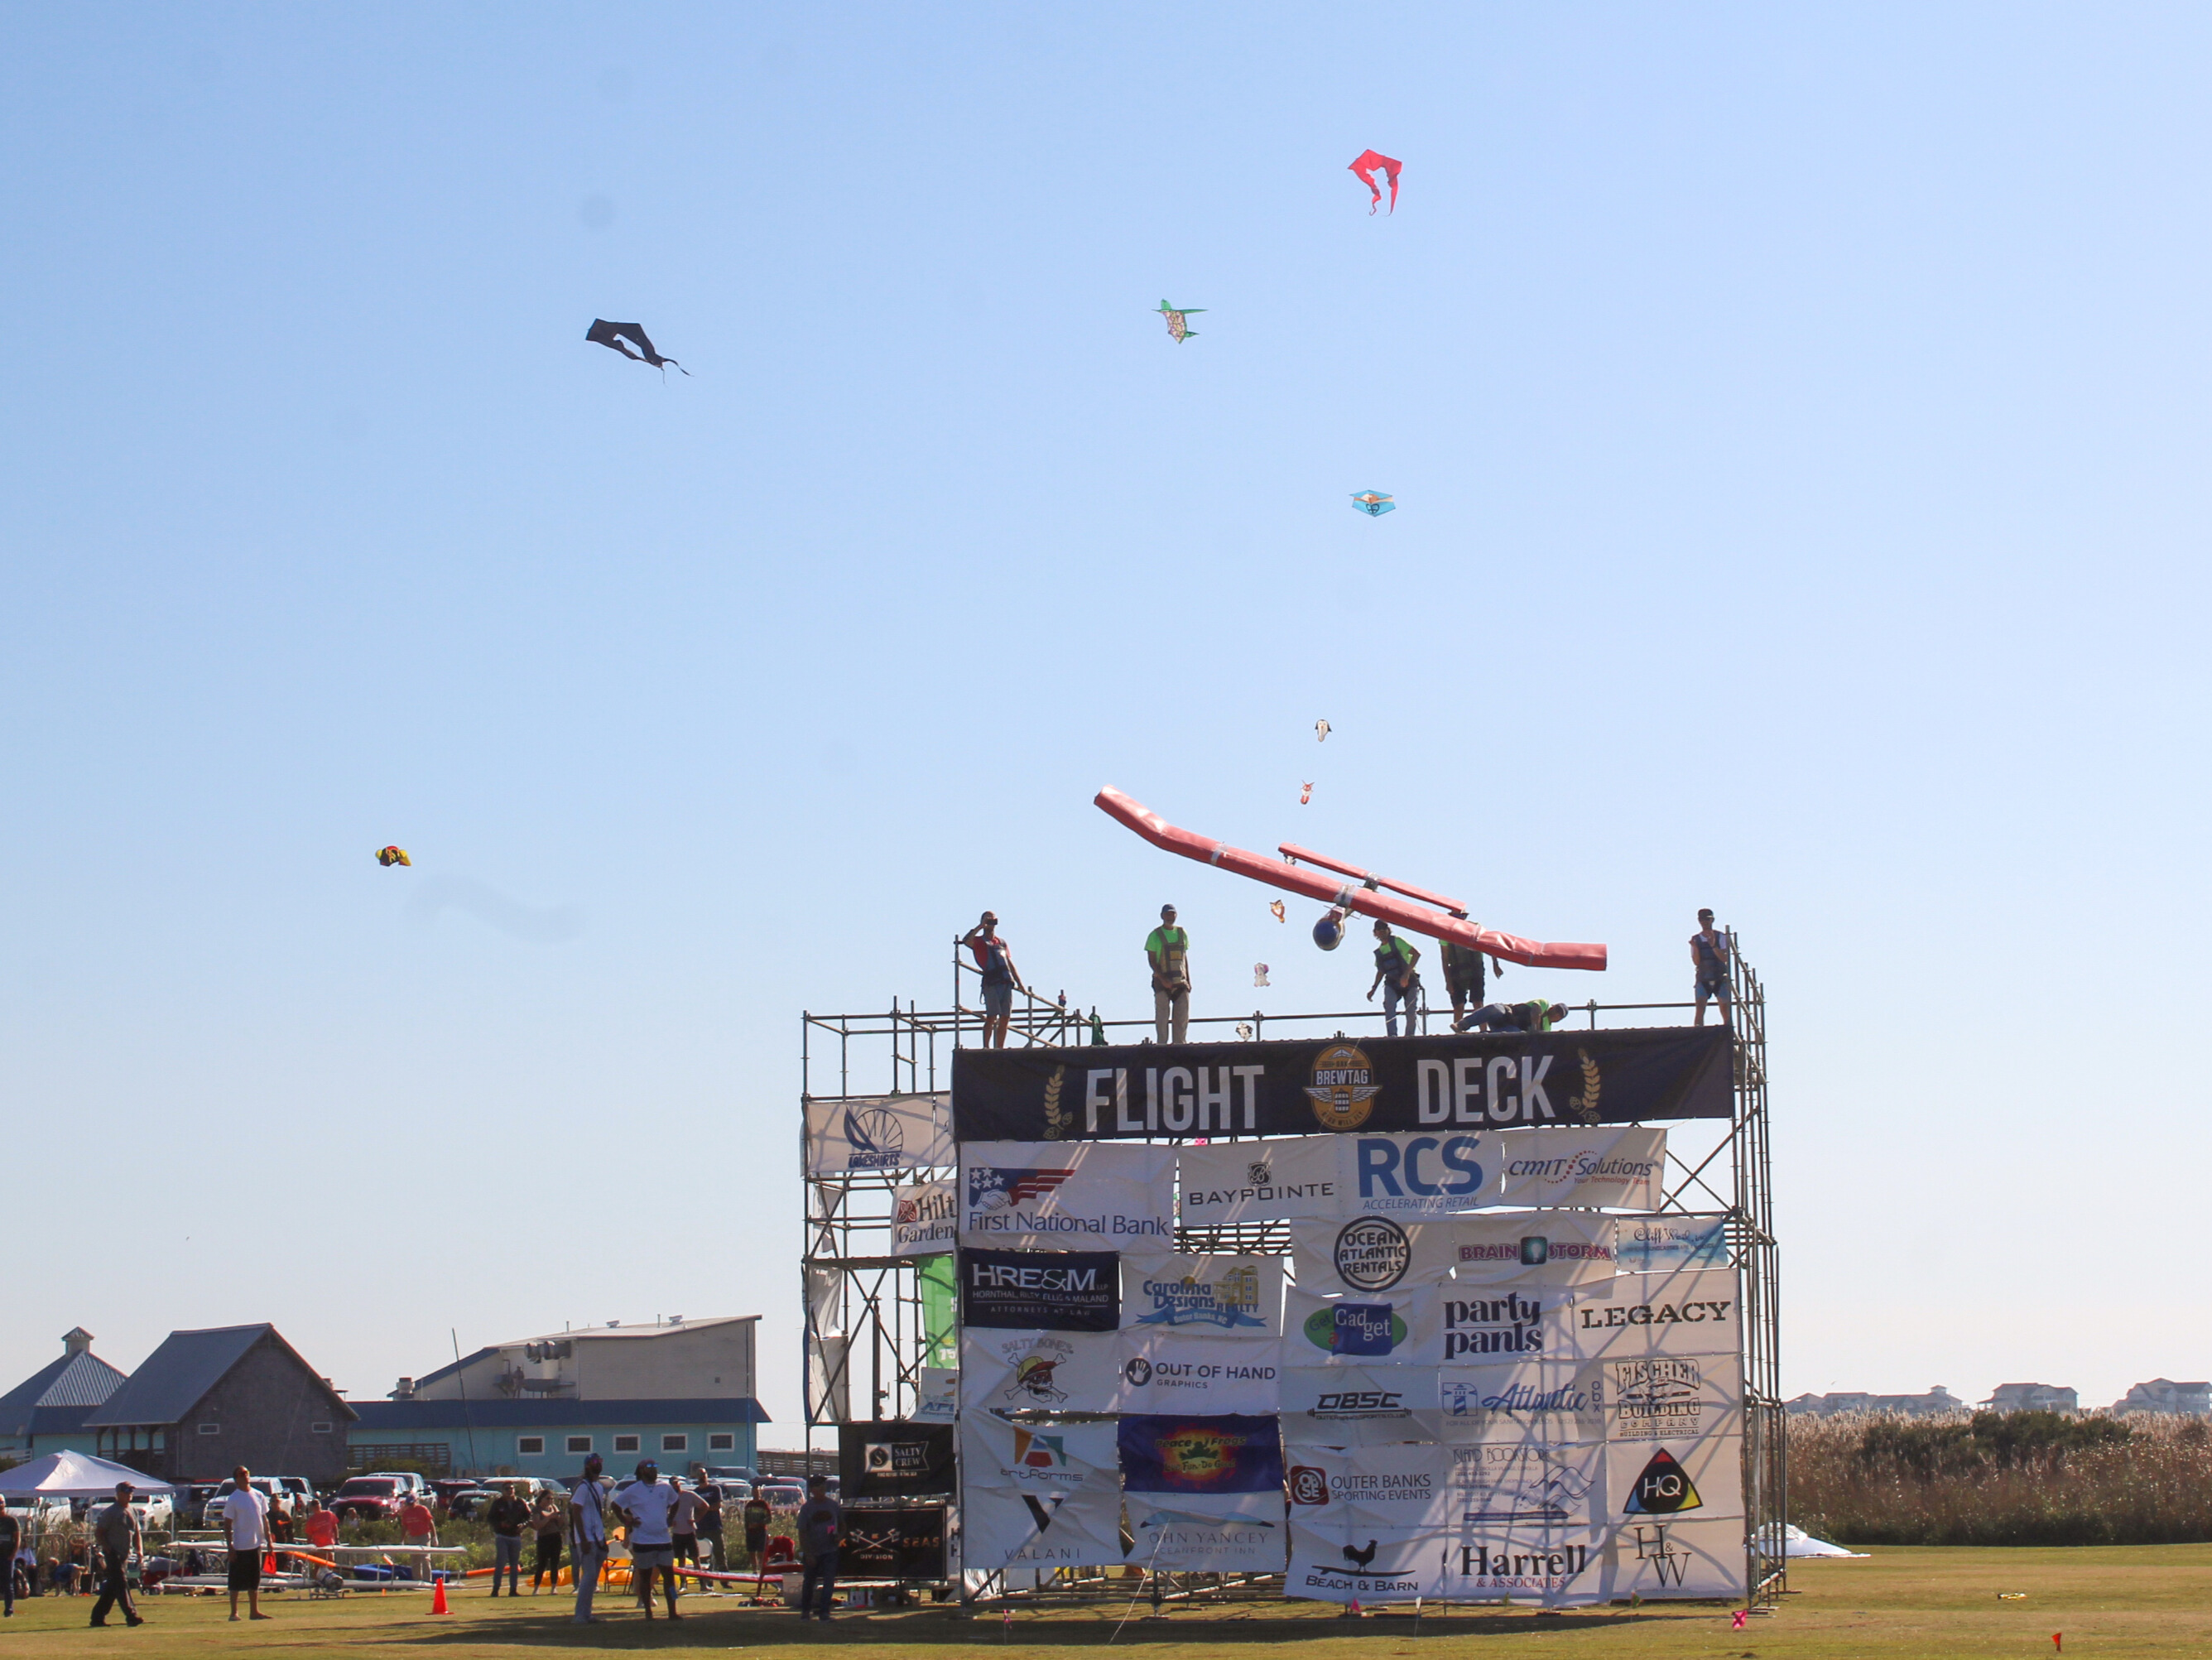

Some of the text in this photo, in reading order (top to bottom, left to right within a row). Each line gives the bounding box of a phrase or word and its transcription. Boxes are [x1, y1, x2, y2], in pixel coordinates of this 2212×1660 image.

[1315, 1069, 1368, 1085] BREWTAG
[1085, 1055, 1556, 1133] FLIGHT DECK
[849, 1154, 901, 1168] LAKESHIRTS
[1357, 1136, 1483, 1198] RCS
[1575, 1157, 1653, 1177] Solutions
[1574, 1176, 1650, 1186] Your Technology Team
[1188, 1182, 1334, 1206] BAYPOINTE
[916, 1193, 958, 1222] Hilt
[1362, 1196, 1479, 1211] ACCELERATING RETAIL
[969, 1211, 1170, 1236] First National Bank
[897, 1225, 955, 1244] Garden
[1344, 1231, 1402, 1247] OCEAN
[1339, 1245, 1407, 1262] ATLANTIC
[1458, 1244, 1612, 1262] BRAIN STORM
[1343, 1260, 1402, 1274] RENTALS
[972, 1263, 1109, 1292] HRE&M LLP
[1142, 1280, 1211, 1297] Carolina
[1041, 1292, 1064, 1302] ELLIS
[1072, 1293, 1109, 1303] MALAND
[1153, 1295, 1216, 1310] Designs
[989, 1305, 1049, 1314] ATTORNEYS
[1216, 1302, 1259, 1313] REALTY
[1443, 1292, 1541, 1330] party
[1581, 1301, 1732, 1330] LEGACY
[1309, 1312, 1333, 1331] Get
[1328, 1331, 1339, 1345] a
[1001, 1336, 1074, 1354] SALTY BONES
[1443, 1322, 1543, 1360] pants
[1156, 1362, 1277, 1380] OUT OF HAND
[1615, 1358, 1701, 1395] FISCHER
[1156, 1379, 1209, 1389] GRAPHICS
[1481, 1382, 1589, 1417] Atlantic
[1618, 1397, 1701, 1419] BUILDING
[1620, 1417, 1700, 1429] COMPANY
[1154, 1436, 1248, 1448] Peace Frogs
[894, 1446, 921, 1457] SALTY
[895, 1456, 921, 1467] CREW
[1000, 1467, 1084, 1482] artforms
[1331, 1474, 1431, 1489] OUTER BANKS
[1331, 1489, 1431, 1501] SPORTING EVENTS
[1643, 1475, 1681, 1499] HQ
[902, 1537, 940, 1548] SEAS
[1147, 1532, 1268, 1544] OHN YANCEY
[1004, 1548, 1080, 1561] VALANI
[1234, 1547, 1256, 1555] INN
[1459, 1544, 1586, 1576] Harrell
[1305, 1575, 1419, 1592] BEACH & BARN
[1476, 1576, 1567, 1589] & ASSOCIATES
